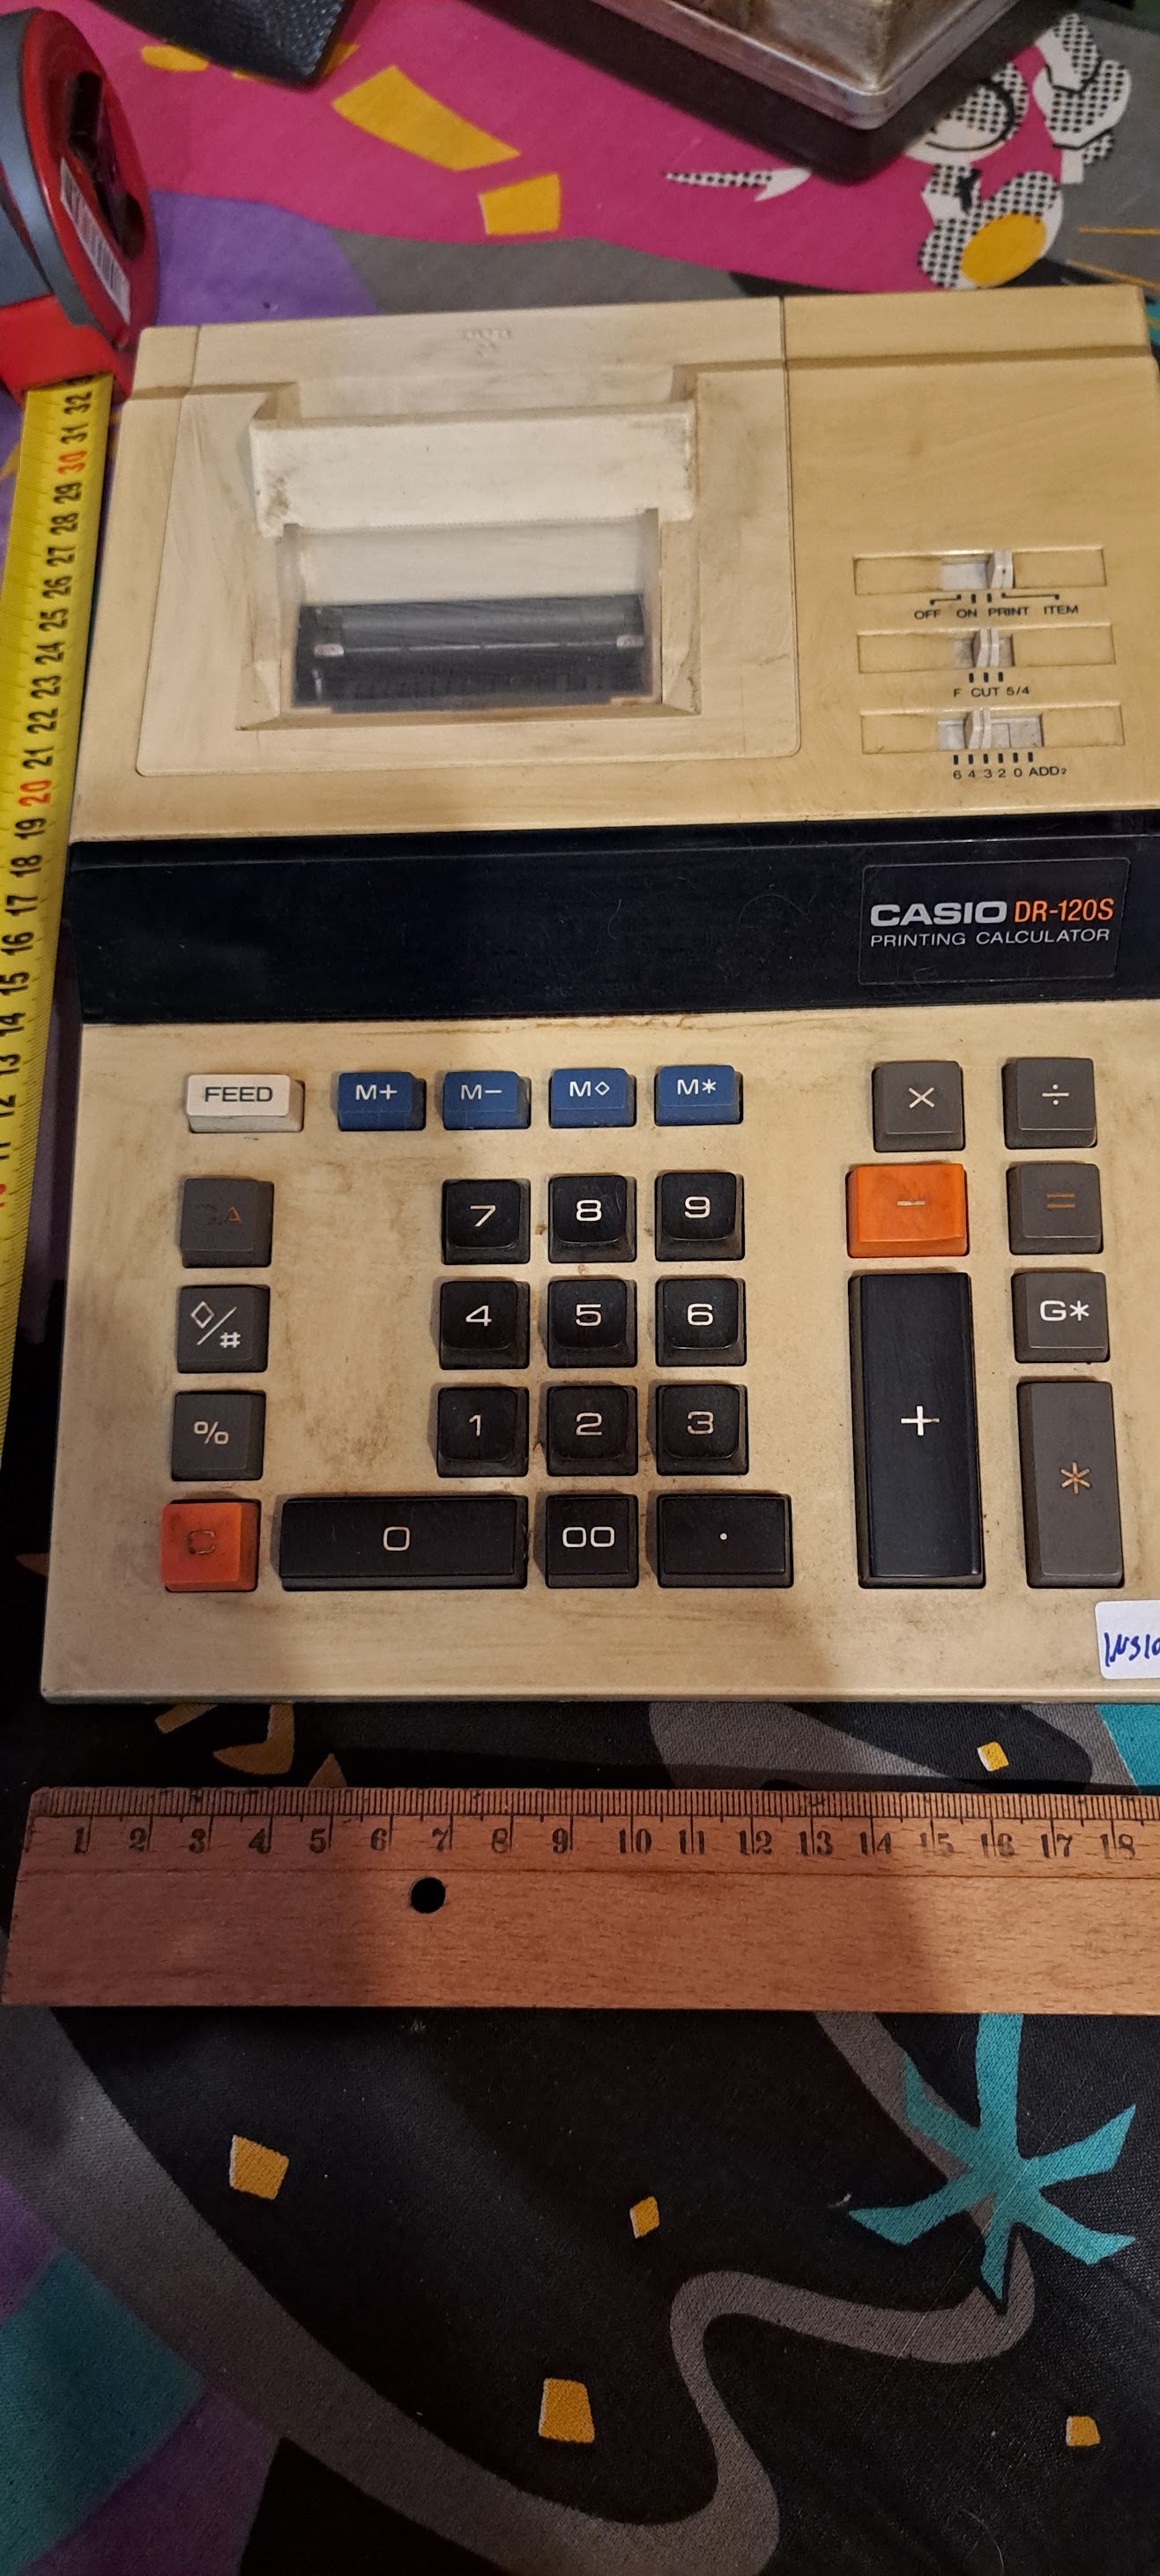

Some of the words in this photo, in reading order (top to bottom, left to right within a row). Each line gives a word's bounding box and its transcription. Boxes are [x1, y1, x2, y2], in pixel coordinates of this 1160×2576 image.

[63, 391, 92, 414] 32
[60, 423, 89, 444] 31
[56, 450, 87, 474] 30
[54, 482, 83, 504] 29
[49, 512, 79, 536] 28
[46, 547, 76, 568] 27
[41, 575, 72, 599] 26
[38, 607, 69, 633] 25
[914, 609, 941, 620] OFF
[956, 608, 978, 619] ON
[988, 607, 1030, 617] PRINT
[1044, 605, 1079, 615] ITEM
[34, 642, 65, 666] 24
[30, 674, 62, 700] 23
[954, 688, 962, 697] F
[970, 687, 999, 697] CUT
[1006, 686, 1030, 696] 5/4
[26, 707, 59, 734] 22
[22, 747, 54, 770] 21
[953, 770, 962, 780] 6
[968, 769, 976, 779] 4
[984, 769, 992, 778] 3
[998, 768, 1006, 778] 2
[1014, 767, 1022, 778] 0
[18, 779, 52, 808] 20
[14, 817, 46, 840] 19
[10, 853, 42, 879] 18
[5, 895, 38, 917] 17
[870, 901, 1008, 927] CASIO
[1014, 897, 1114, 923] DR-120S
[1, 931, 34, 957] 16
[871, 933, 966, 948] PRINTING
[976, 928, 1110, 945] CALCULATOR
[0, 972, 29, 996] 15
[0, 1012, 26, 1037] 14
[204, 1086, 273, 1102] FEED
[355, 1084, 398, 1100] M+
[470, 1205, 496, 1227] 7
[576, 1199, 602, 1222] 8
[684, 1196, 710, 1218] 9
[465, 1305, 492, 1327] 4
[576, 1304, 602, 1327] 5
[687, 1303, 714, 1326] 6
[193, 1420, 229, 1445] %
[468, 1414, 481, 1437] 1
[576, 1411, 603, 1436] 2
[687, 1411, 714, 1435] 3
[188, 1530, 215, 1555] C
[383, 1526, 411, 1552] 0
[561, 1526, 615, 1548] 00
[73, 1828, 88, 1854] 1
[130, 1827, 147, 1852] 2
[189, 1828, 205, 1854] 3
[249, 1828, 271, 1855] 4
[309, 1828, 326, 1853] 5
[370, 1828, 387, 1851] 6
[432, 1828, 450, 1852] 7
[491, 1828, 508, 1854] 8
[552, 1828, 569, 1853] 9
[618, 1828, 652, 1854] 10
[679, 1828, 705, 1855] 11
[739, 1829, 772, 1856] 12
[799, 1830, 833, 1856] 13
[859, 1831, 891, 1856] 14
[920, 1832, 954, 1858] 15
[980, 1833, 1015, 1858] 16
[1041, 1833, 1073, 1858] 17
[1099, 1834, 1135, 1858] 18
